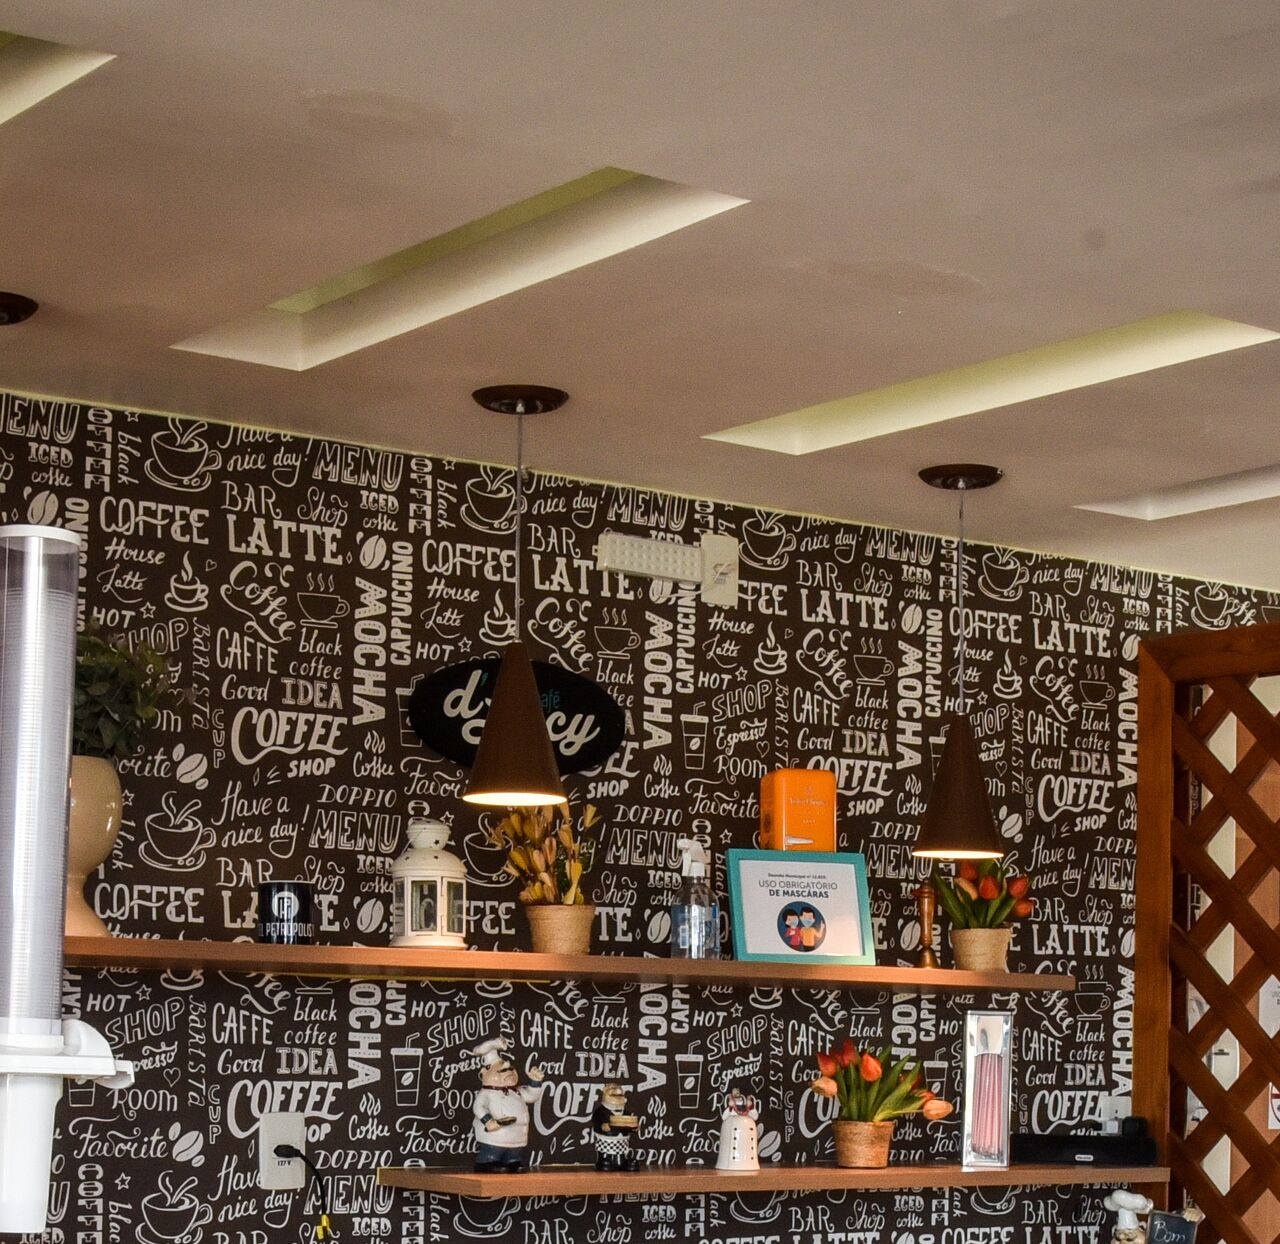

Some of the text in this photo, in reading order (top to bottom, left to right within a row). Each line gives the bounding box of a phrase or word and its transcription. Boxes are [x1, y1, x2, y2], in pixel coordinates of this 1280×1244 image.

[28, 443, 73, 468] ICED
[228, 450, 267, 472] nice
[312, 441, 405, 491] MENU
[222, 481, 282, 519] BAR
[298, 487, 348, 528] Shop
[360, 490, 399, 514] ICED
[99, 496, 209, 545] COFFEE
[104, 538, 166, 565] House
[228, 514, 344, 566] LATTE
[800, 535, 830, 552] nice
[427, 577, 479, 602] House
[796, 560, 842, 591] BAR
[854, 562, 893, 598] Shop
[902, 565, 932, 584] ICED
[1032, 569, 1061, 583] nice
[390, 541, 413, 665] CAPPUCCINO
[390, 541, 413, 666] CAPPUCCINO
[1029, 591, 1069, 622] BAR
[1080, 595, 1115, 629] Shop
[1122, 598, 1150, 616] ICED
[1176, 587, 1189, 627] black
[708, 611, 754, 635] House
[1033, 619, 1111, 658] LATTE
[217, 627, 278, 674] CAFFE
[299, 627, 343, 656] black
[348, 577, 388, 726] MOCHA
[415, 641, 455, 662] HOT
[702, 636, 738, 668] Latte
[925, 608, 942, 717] CAPPUCCINO
[221, 674, 272, 701] Good
[281, 678, 344, 709] IDEA
[642, 611, 673, 749] MOCHA
[698, 671, 732, 691] HOT
[793, 686, 839, 727] CAFFE
[897, 640, 922, 769] MOCHA
[231, 706, 348, 765] COFFEE
[713, 718, 768, 755] Espresso
[848, 714, 889, 730] coffee
[1027, 710, 1068, 748] CAFFE
[1081, 710, 1111, 732] black
[1117, 667, 1138, 788] MOCHA
[798, 728, 833, 751] Good
[842, 729, 889, 755] IDEA
[1075, 735, 1111, 751] coffee
[1032, 749, 1062, 769] Good
[1070, 752, 1111, 776] IDEA
[211, 780, 291, 825] Have a
[318, 784, 397, 807] DOPPIO
[685, 778, 760, 818] Favorite
[847, 798, 885, 817] SHOP
[308, 809, 401, 853] MENU
[613, 805, 682, 826] DOPPIO
[1074, 815, 1107, 832] SHOP
[1027, 836, 1076, 870] Have a
[593, 871, 637, 906] Shop
[759, 880, 837, 889] USO OBRIGATÓRIO
[1079, 896, 1113, 925] Shop
[1033, 925, 1109, 956] LATTE
[87, 994, 131, 1012] HOT
[105, 997, 184, 1048] SHOP
[211, 1002, 272, 1045] CAFFE
[284, 1024, 337, 1045] coffee
[427, 1004, 498, 1054] SHOP
[694, 1011, 727, 1028] HOT
[582, 1035, 629, 1051] coffee
[1022, 1028, 1062, 1062] CAFFE
[218, 1049, 265, 1075] Good
[276, 1048, 338, 1074] IDEA
[711, 1053, 763, 1093] Espresso
[1064, 1063, 1106, 1085] IDEA
[69, 1115, 168, 1159] Favorite
[315, 1150, 392, 1169] DOPPIO
[219, 1188, 301, 1228] nice day!
[788, 1207, 834, 1233] BAR
